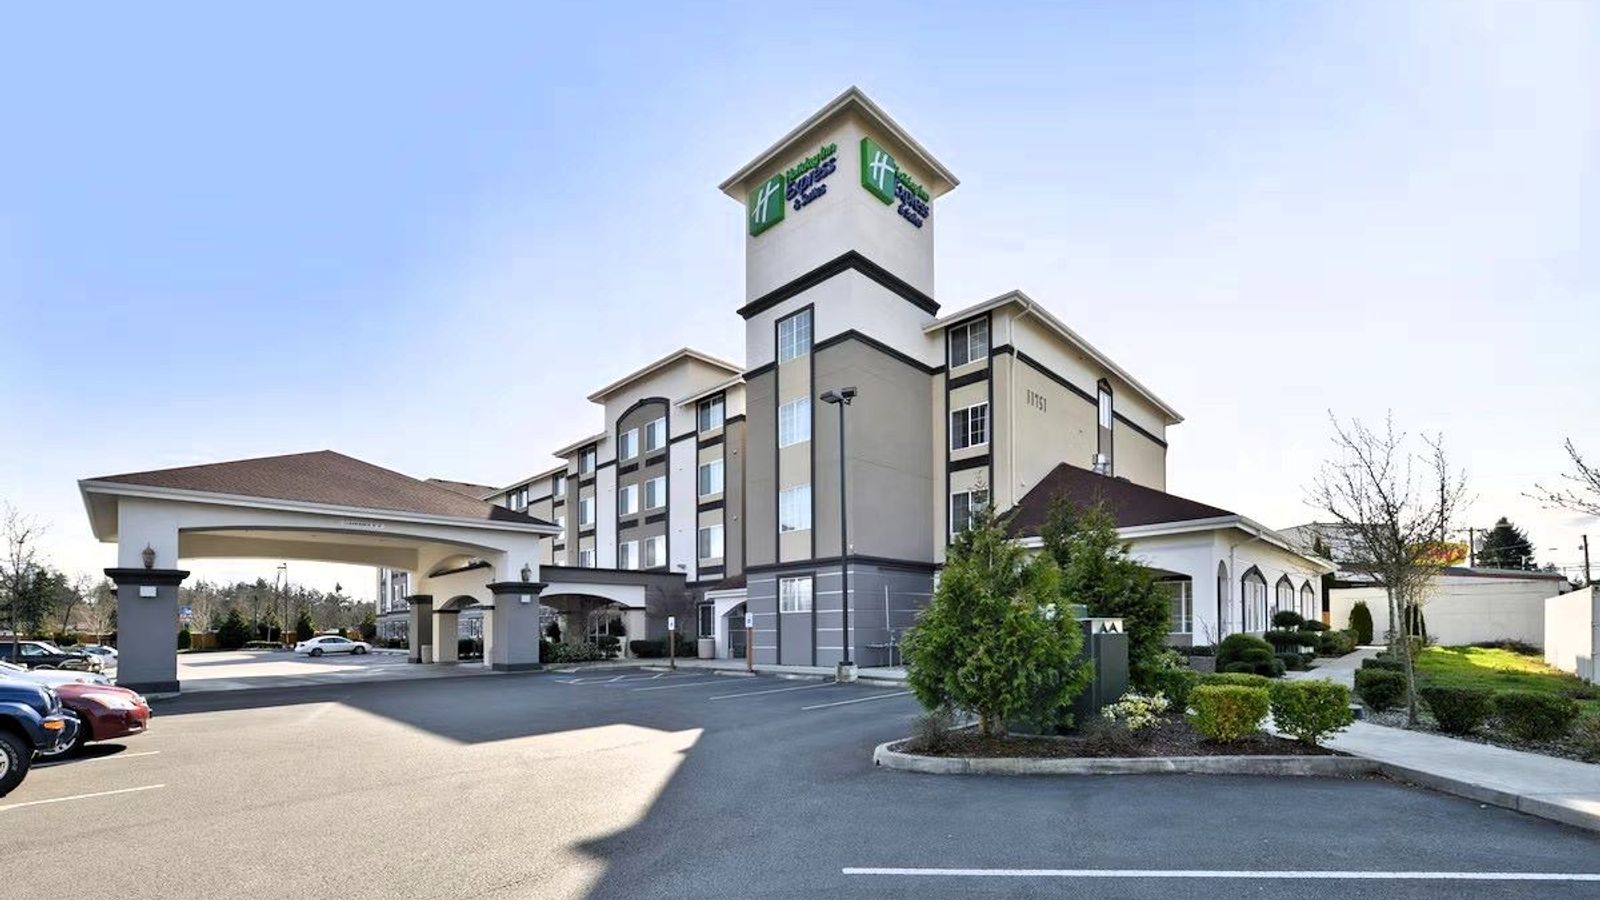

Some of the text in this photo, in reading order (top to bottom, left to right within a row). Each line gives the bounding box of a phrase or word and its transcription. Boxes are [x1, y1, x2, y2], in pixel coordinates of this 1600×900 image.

[786, 142, 837, 184] Holiday Inn
[786, 157, 837, 201] Express
[801, 183, 828, 207] Suites
